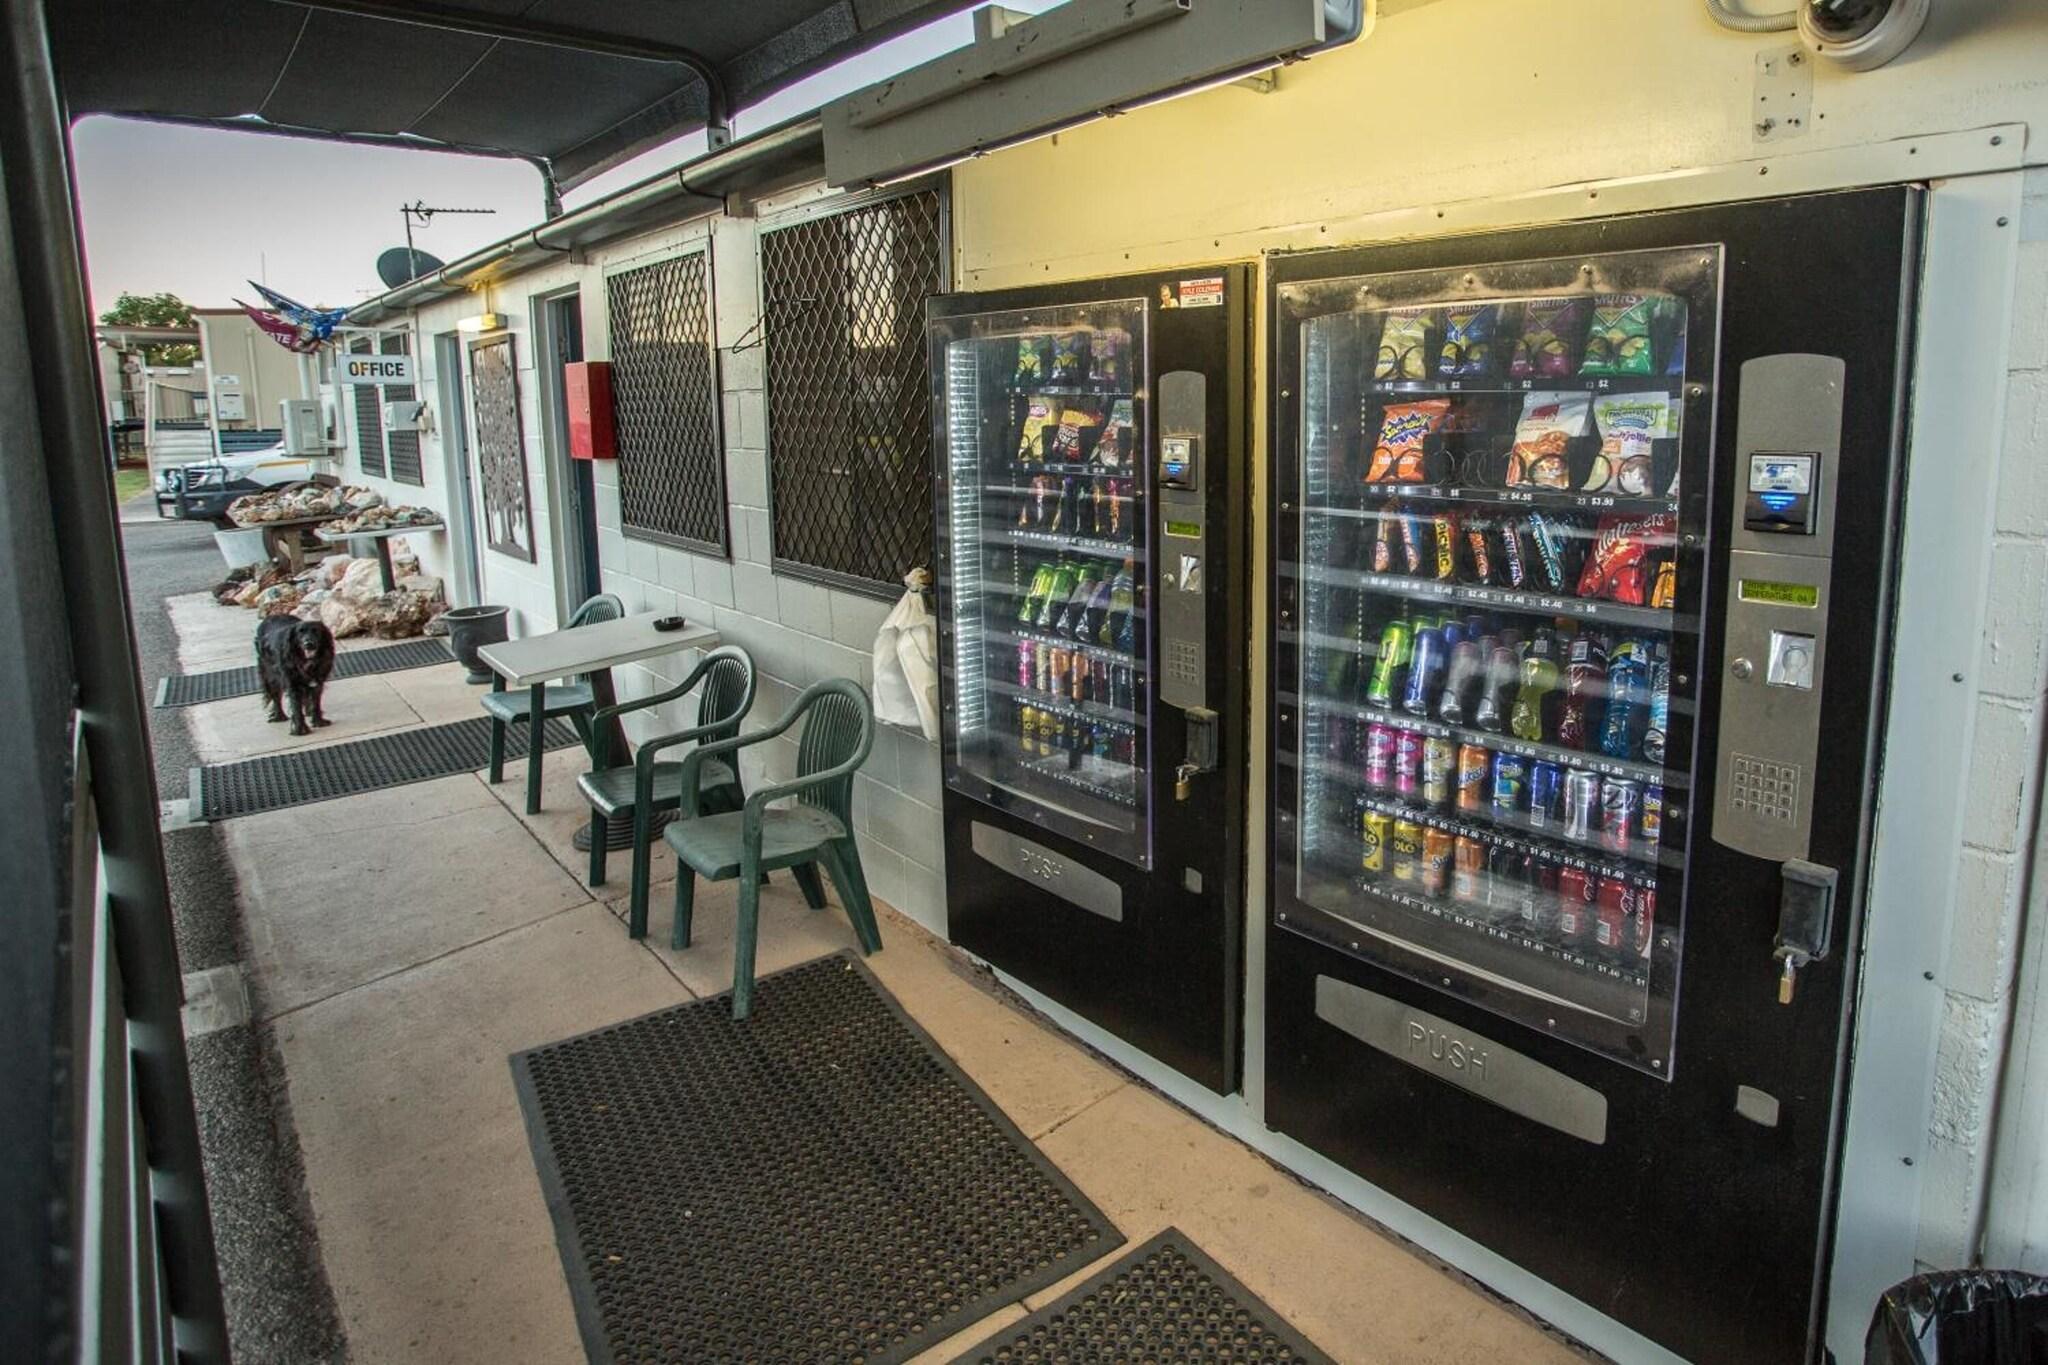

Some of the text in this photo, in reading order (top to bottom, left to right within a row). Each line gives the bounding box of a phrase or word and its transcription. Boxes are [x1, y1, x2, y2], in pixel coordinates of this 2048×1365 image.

[349, 361, 406, 377] OFFICE
[1598, 379, 1609, 388] $2
[1540, 598, 1563, 608] $2.40
[1407, 1020, 1488, 1081] PUSH
